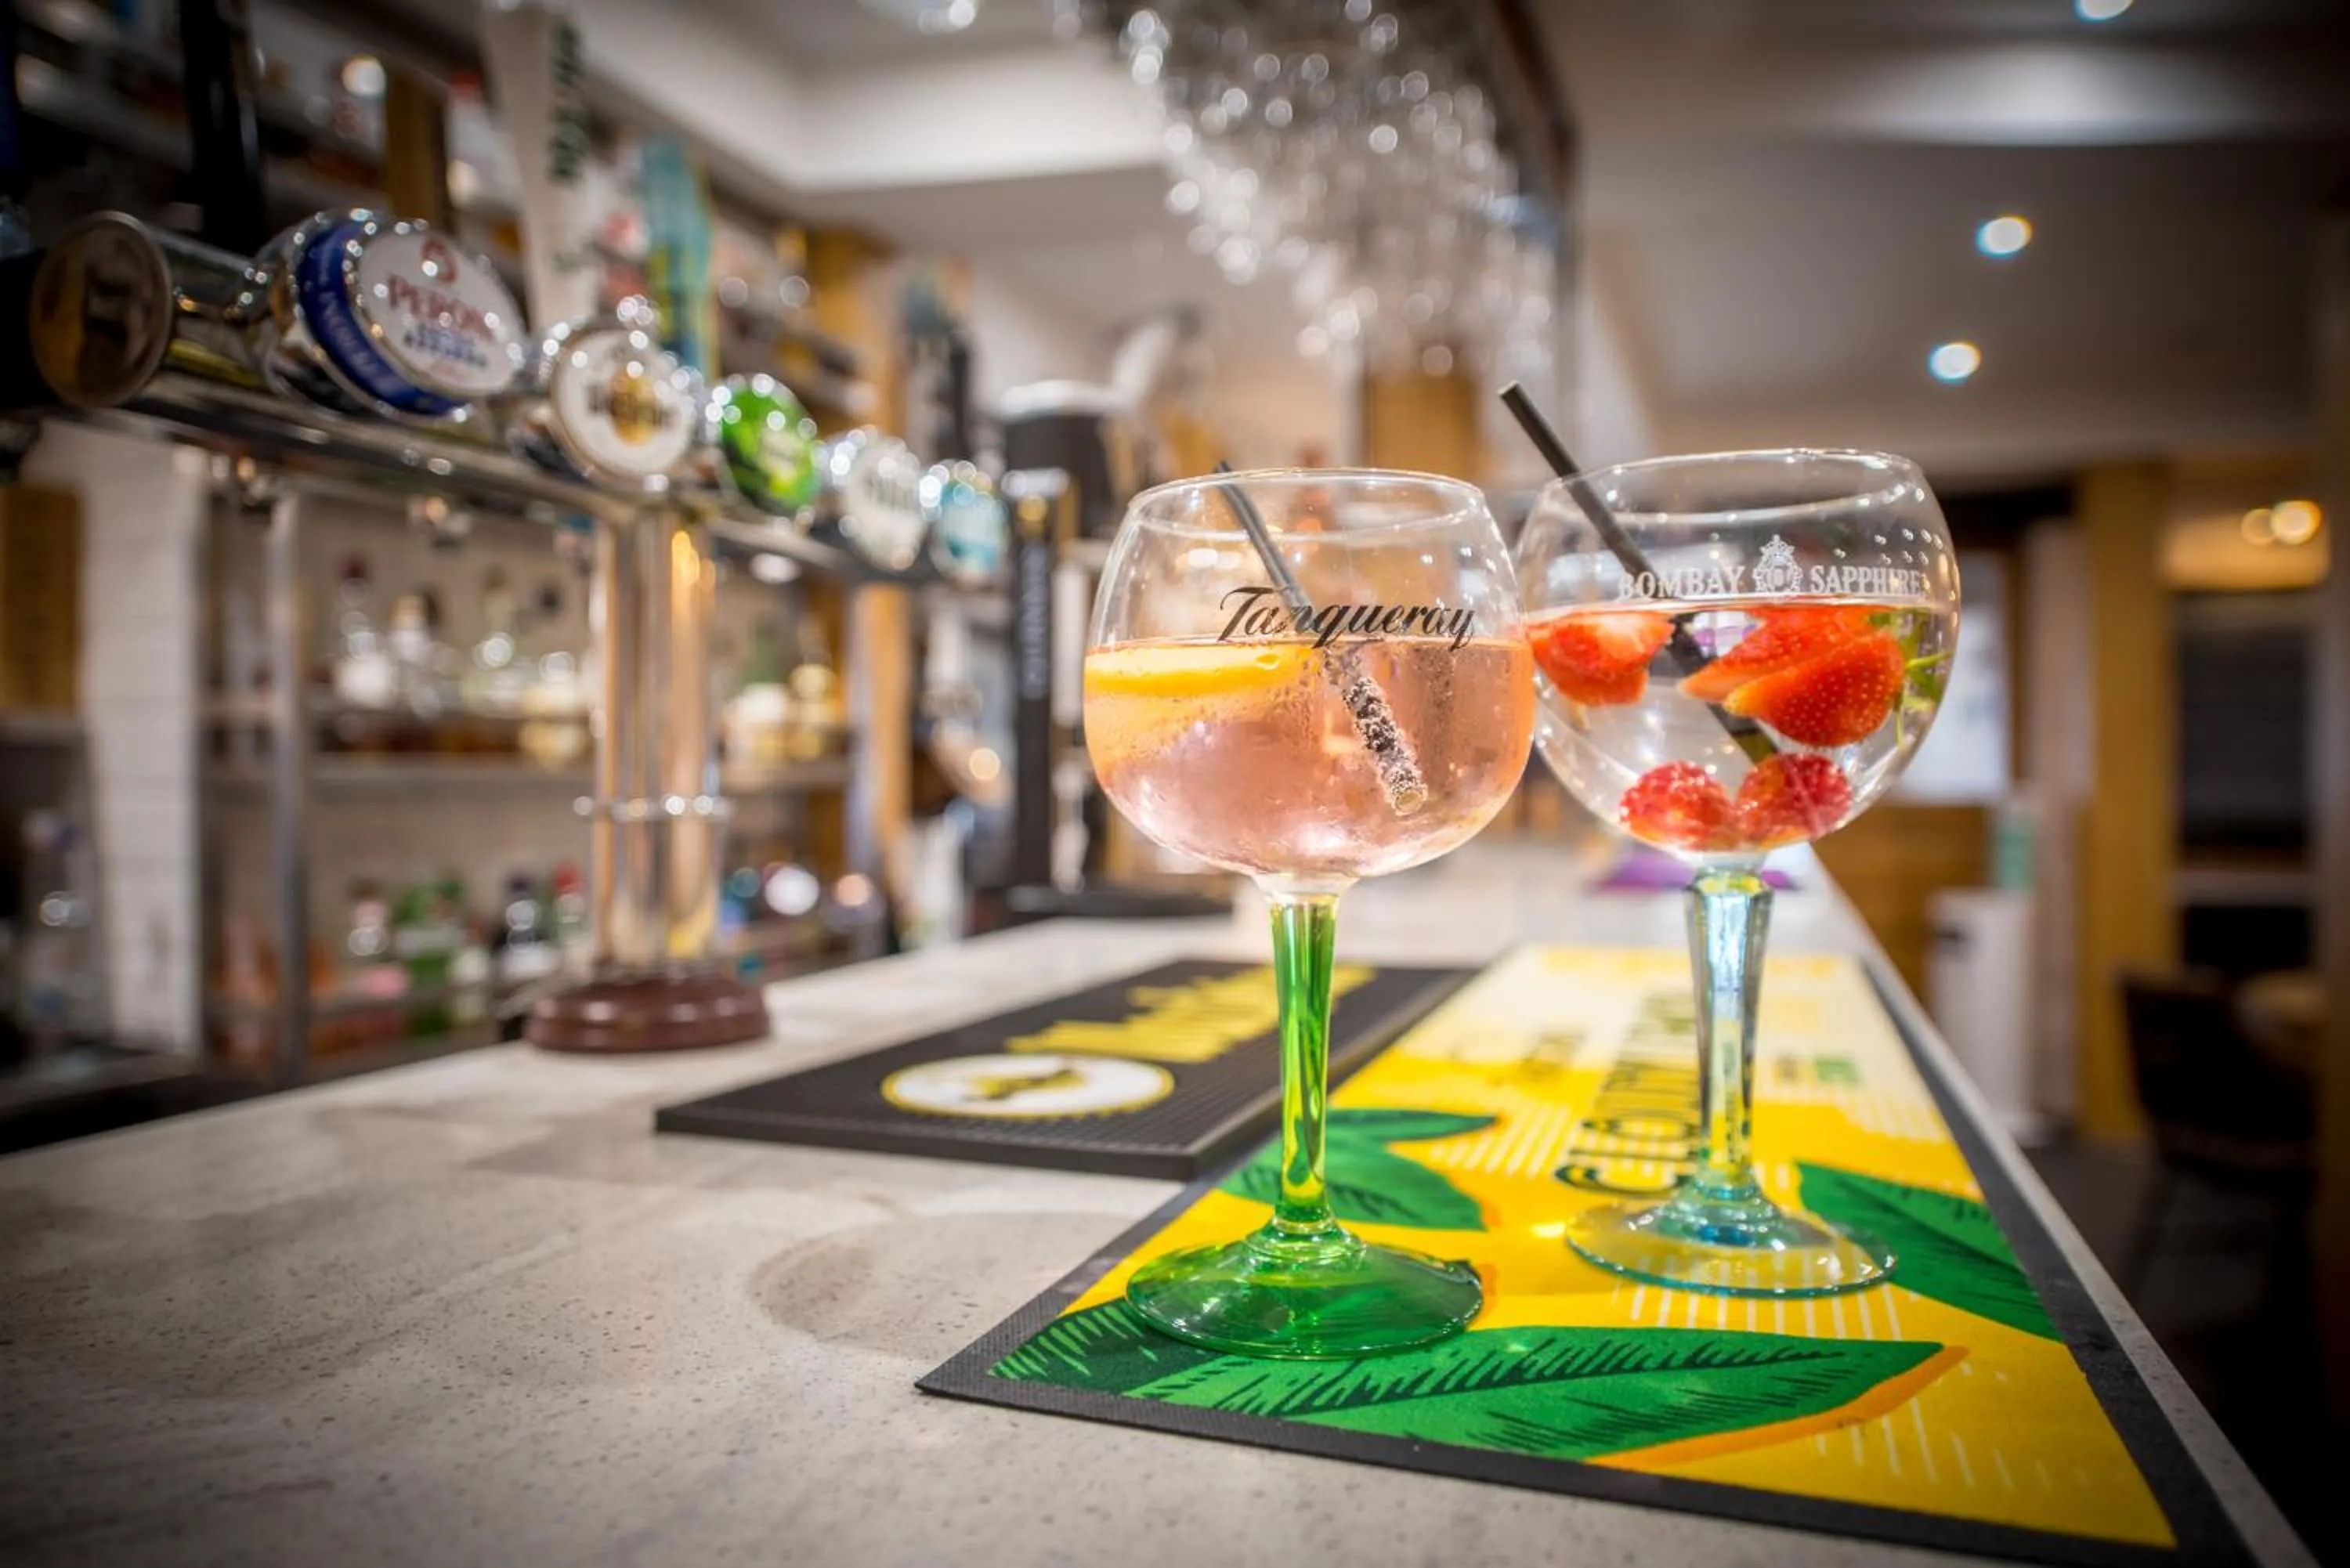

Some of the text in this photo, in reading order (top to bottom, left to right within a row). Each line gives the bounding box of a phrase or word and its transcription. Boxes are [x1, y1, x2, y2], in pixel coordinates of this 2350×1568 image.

[1616, 564, 1926, 602] BOMBAY SAPPHIRE
[1217, 586, 1476, 652] Tanqueray
